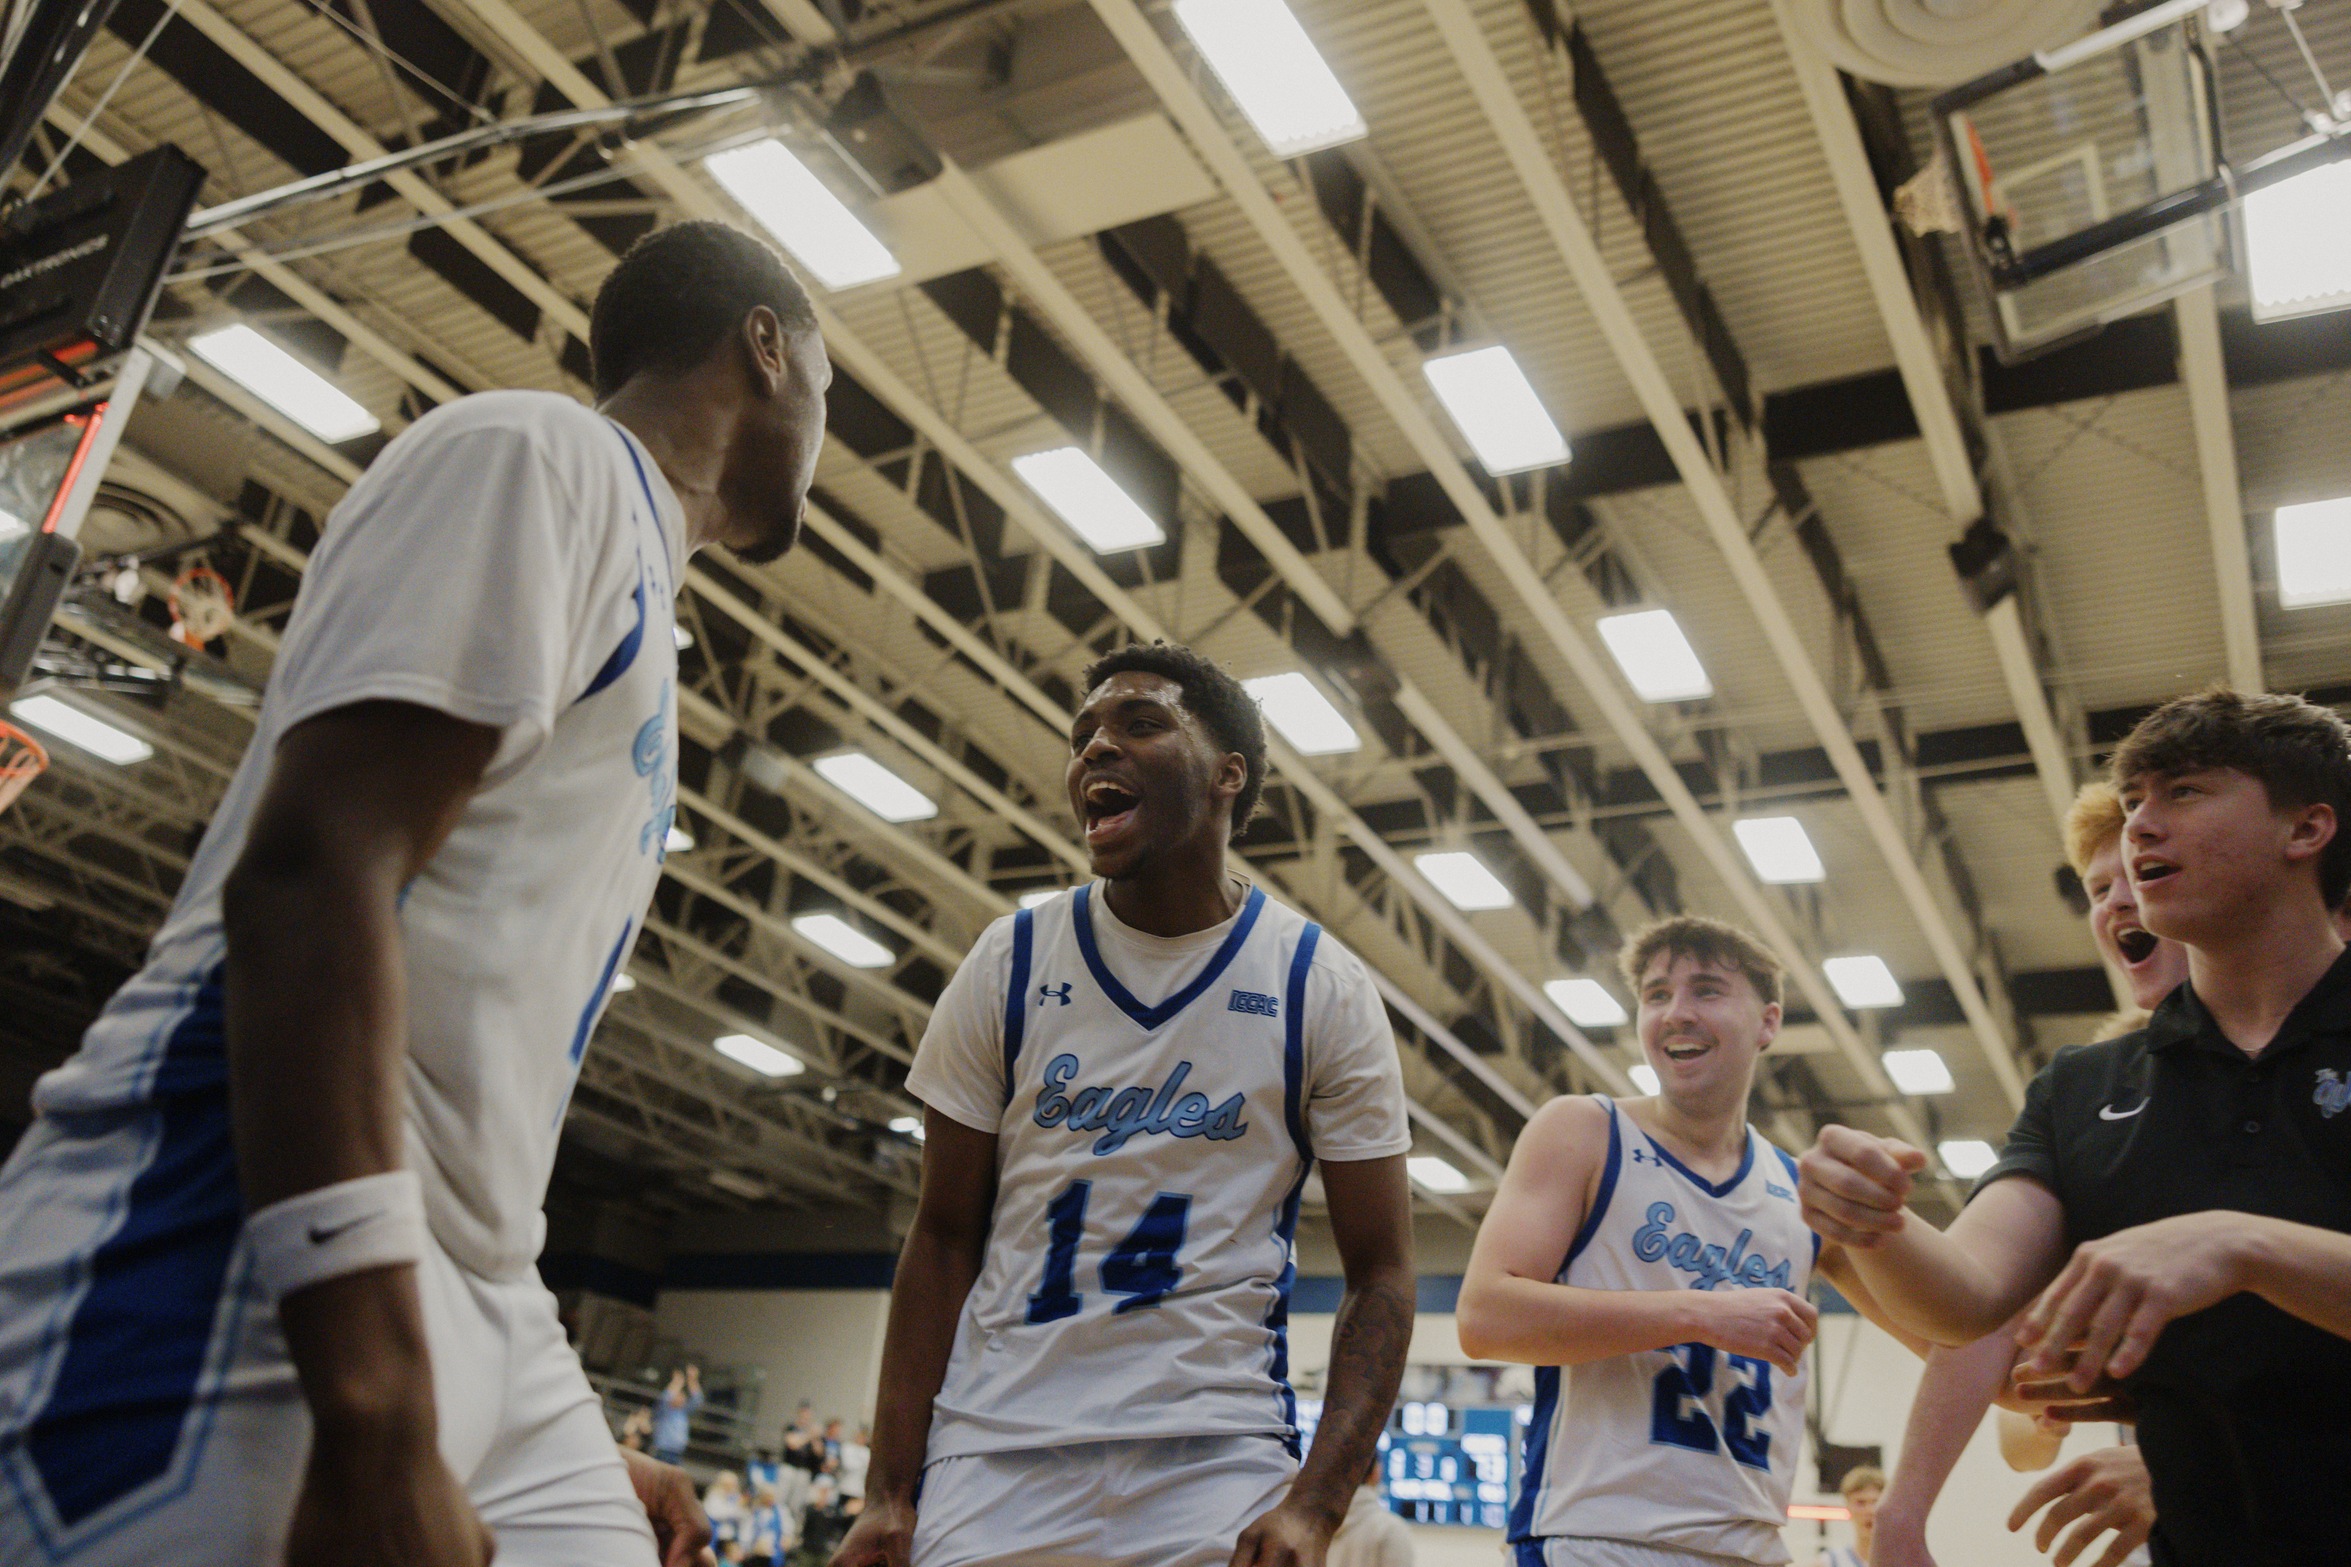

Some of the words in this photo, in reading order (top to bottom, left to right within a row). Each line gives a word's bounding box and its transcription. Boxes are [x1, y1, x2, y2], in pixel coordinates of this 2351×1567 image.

[1033, 1053, 1248, 1157] Eagles
[1024, 1178, 1194, 1325] 14
[1632, 1201, 1795, 1292] Eagles
[1648, 1342, 1772, 1474] 22
